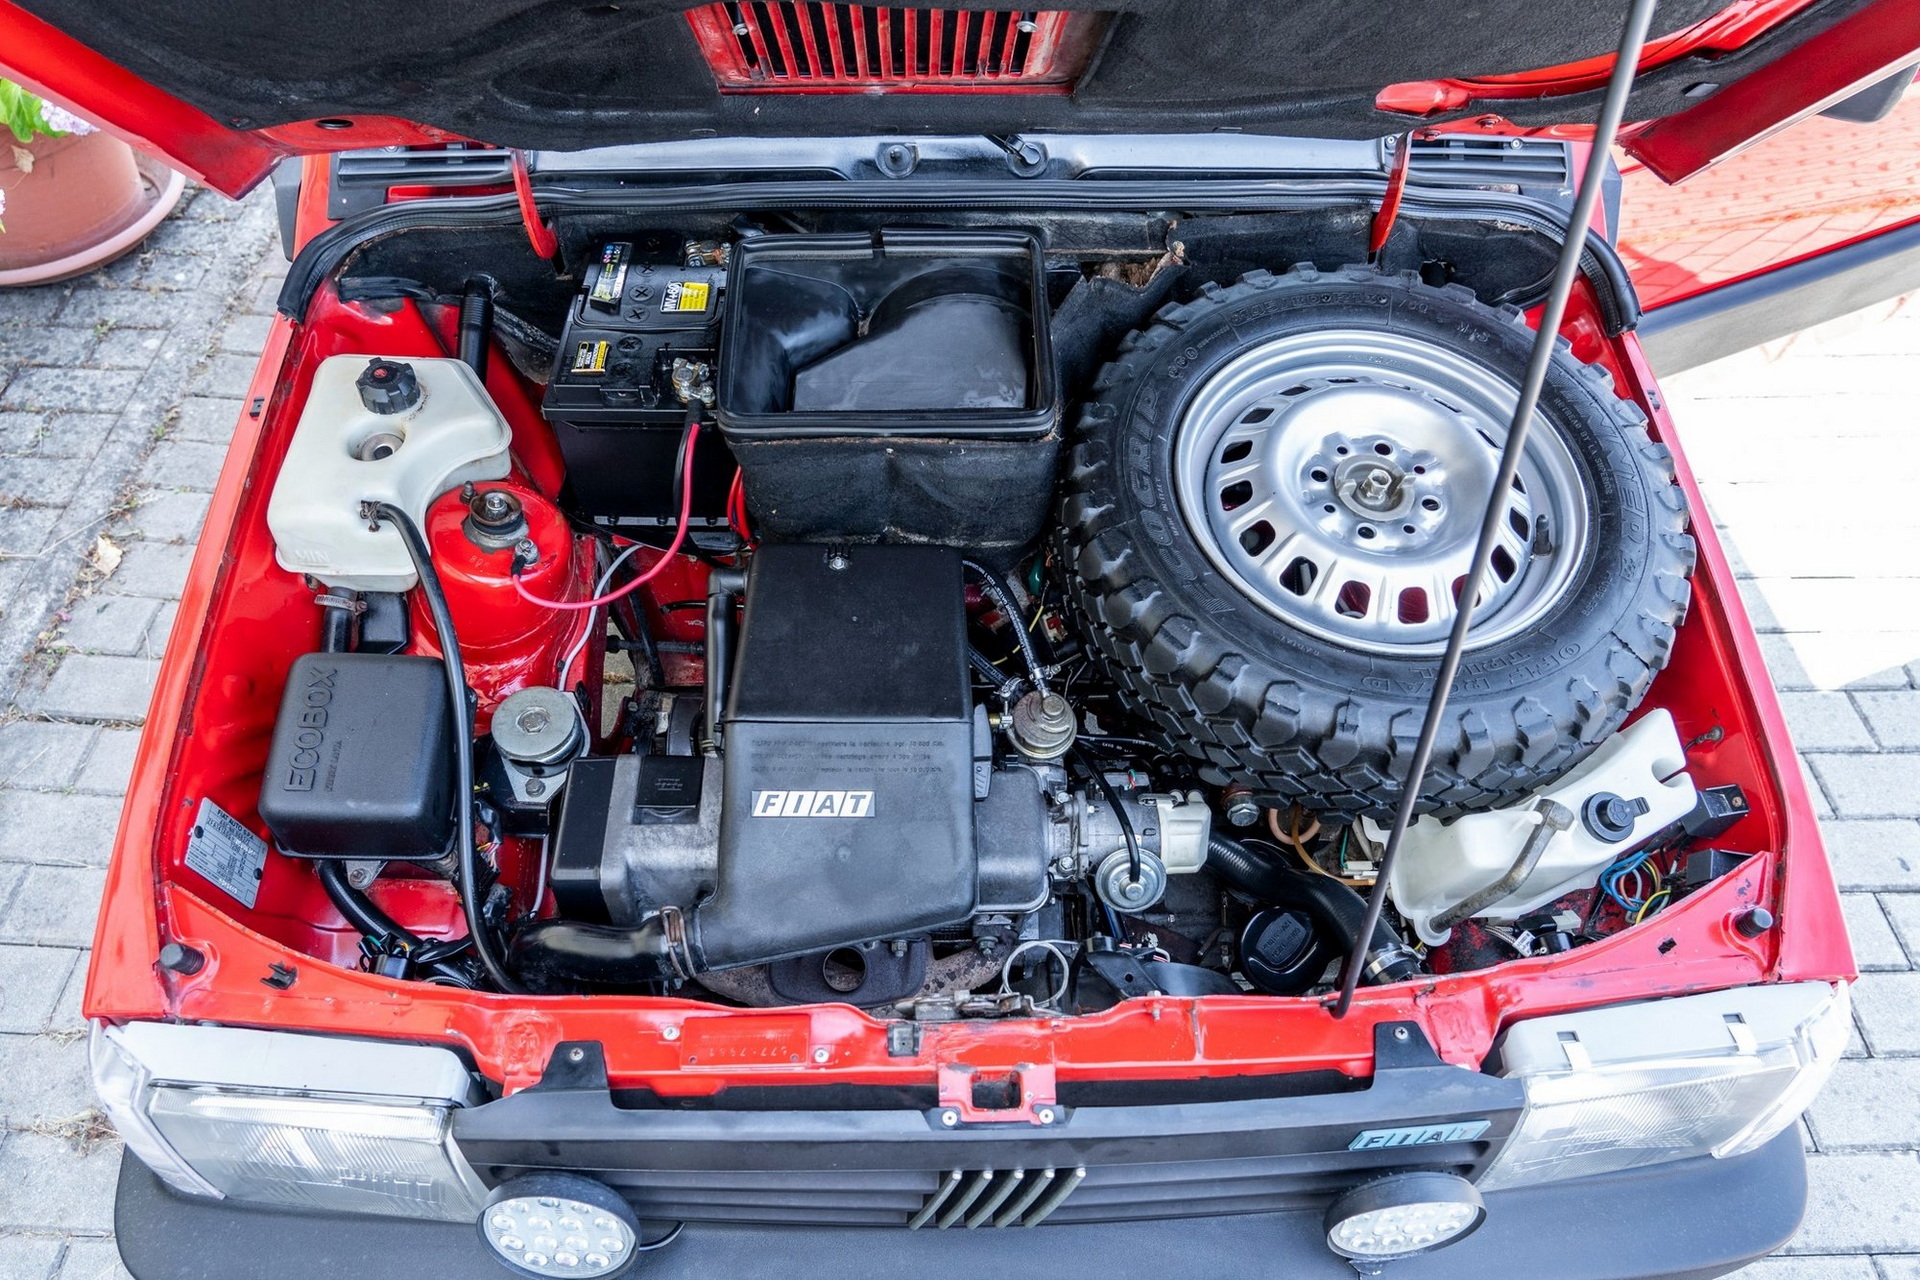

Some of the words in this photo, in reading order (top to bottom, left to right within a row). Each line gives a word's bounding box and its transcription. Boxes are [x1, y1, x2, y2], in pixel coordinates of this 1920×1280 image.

[1128, 384, 1235, 614] ECOGRIP
[283, 666, 338, 792] ECOBOX
[757, 792, 871, 816] FIAT
[217, 809, 229, 821] FIAT
[229, 818, 243, 832] AUTO
[1354, 1121, 1487, 1150] FIAT
